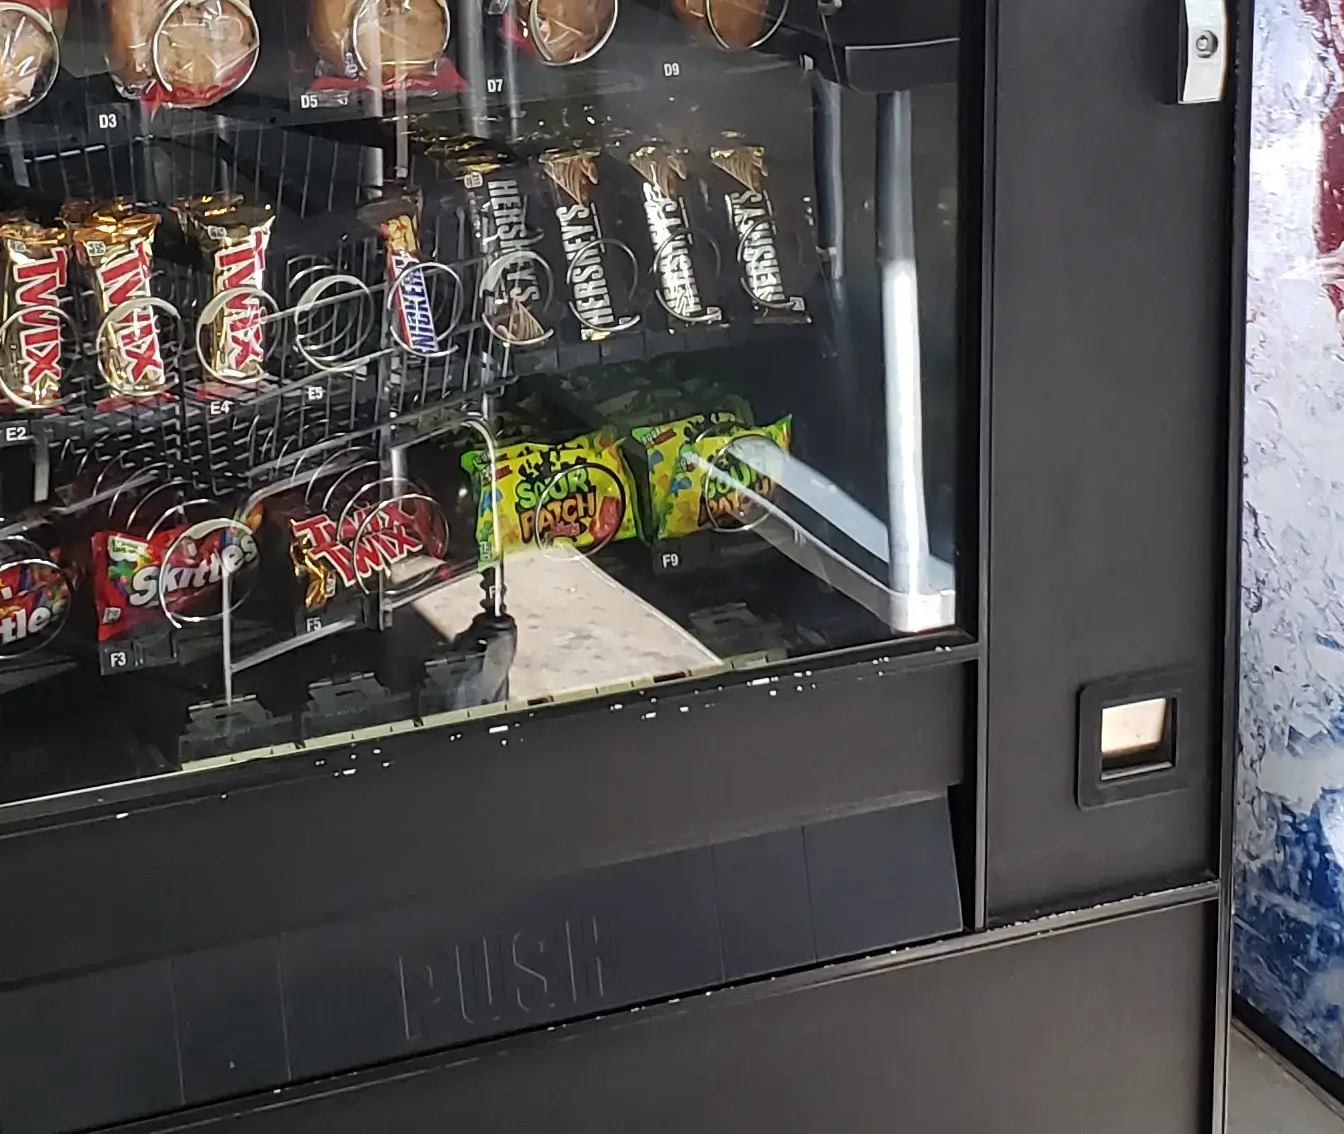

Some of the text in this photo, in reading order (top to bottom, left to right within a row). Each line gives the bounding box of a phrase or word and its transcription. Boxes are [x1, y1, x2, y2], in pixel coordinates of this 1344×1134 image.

[664, 62, 680, 77] D9
[487, 78, 504, 93] D7
[301, 94, 318, 109] D5
[98, 114, 118, 129] D3
[555, 204, 615, 329] HERSHEY'S
[215, 229, 265, 370] TWIX
[12, 247, 68, 387] TWIX
[97, 237, 165, 384] TWIX
[308, 386, 323, 401] E5
[210, 401, 230, 415] E4
[6, 426, 27, 441] E2
[516, 467, 590, 509] SOUR
[519, 485, 597, 544] PATCH
[307, 523, 424, 588] TWIX
[662, 553, 679, 569] F9
[306, 616, 322, 633] F5
[110, 652, 127, 668] F3
[399, 914, 606, 1040] PUSH
